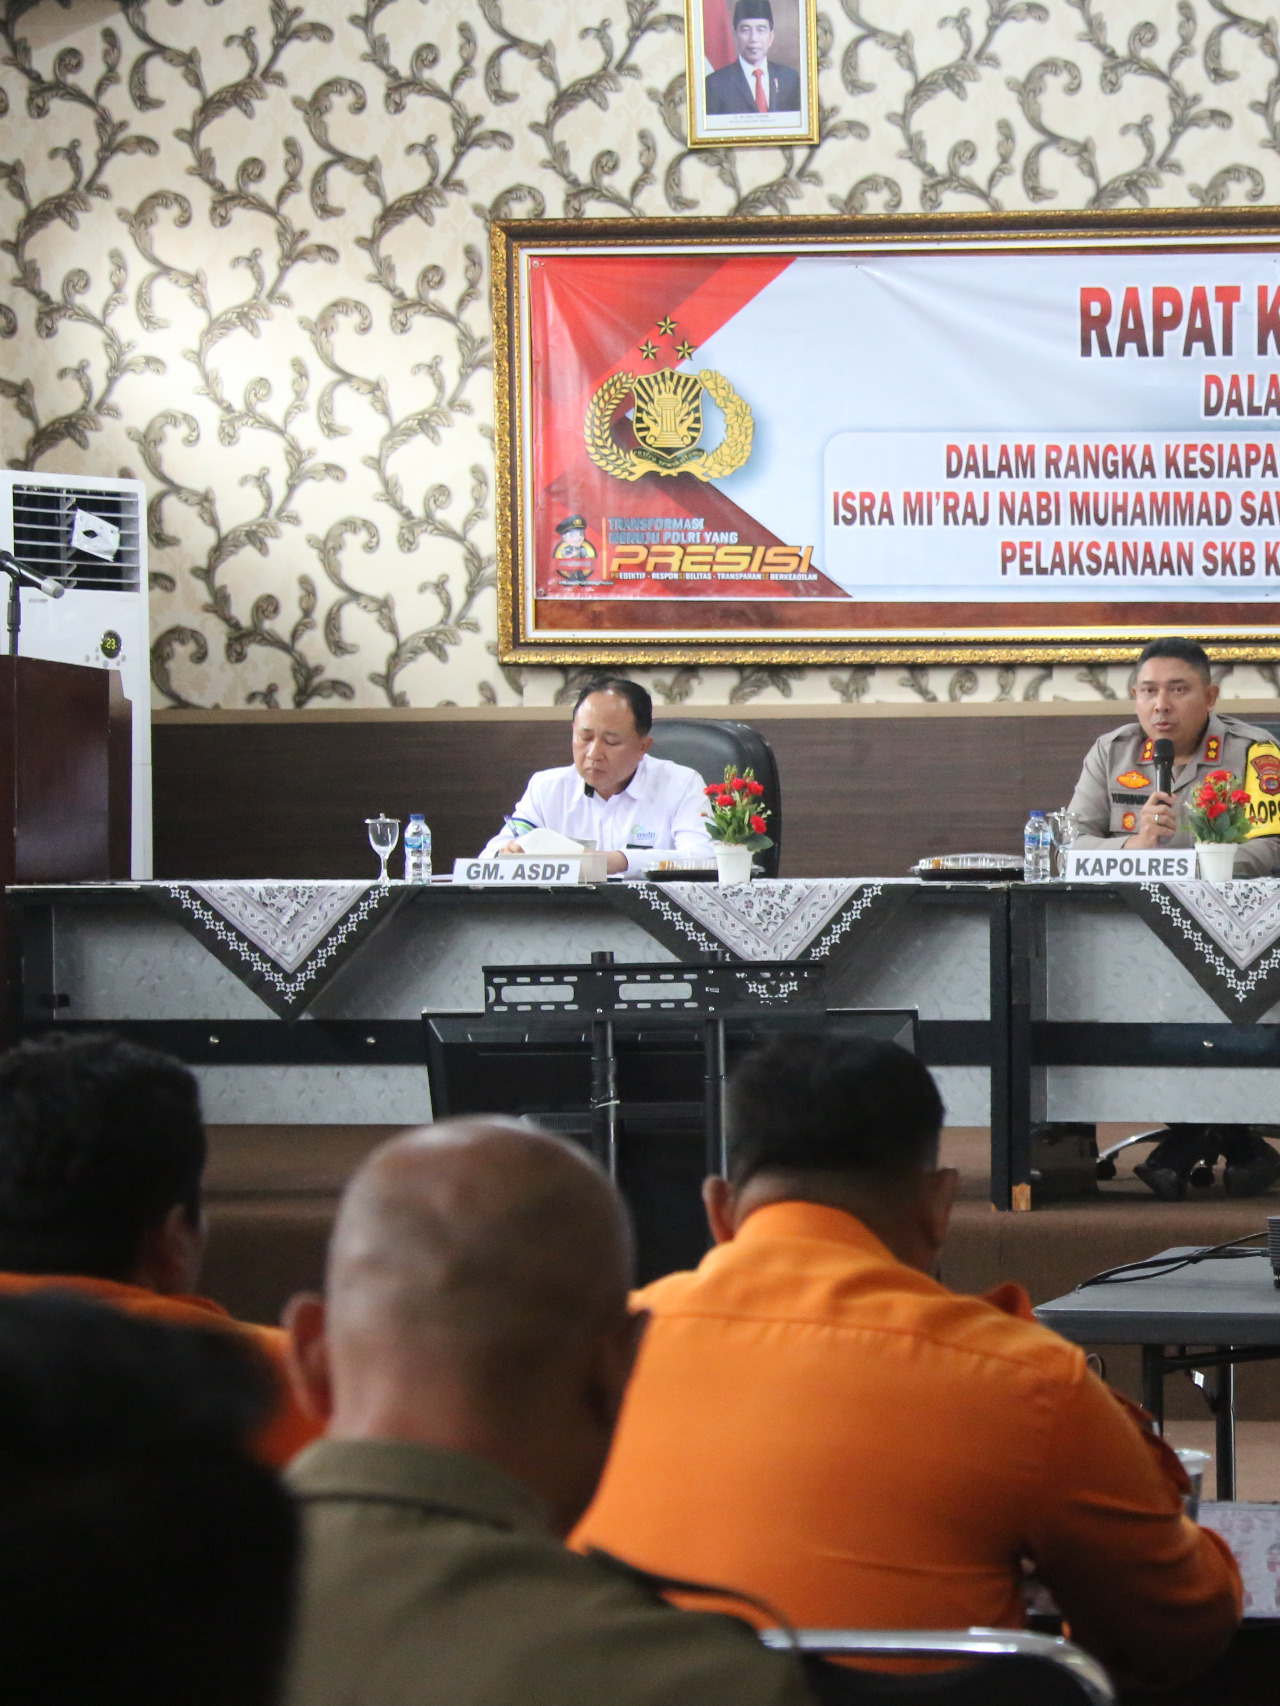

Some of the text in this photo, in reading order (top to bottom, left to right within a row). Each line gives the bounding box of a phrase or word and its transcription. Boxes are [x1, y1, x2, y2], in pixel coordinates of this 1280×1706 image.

[1080, 286, 1240, 357] RAPAT
[946, 444, 1035, 479] DALAM
[1045, 444, 1156, 479] RANGKA
[833, 491, 895, 526] ISRA
[903, 491, 989, 526] MI'RAJ
[999, 491, 1060, 526] NABI
[1070, 490, 1231, 526] MUHAMMAD
[608, 517, 705, 531] TRANSFORMASI
[609, 531, 739, 545] MENUJU POLRI YANG
[609, 545, 815, 573] PRESISI
[1001, 541, 1194, 576] PELAKSANAAN
[1202, 540, 1256, 576] SKB
[770, 572, 818, 581] BERKEADILAN
[636, 831, 656, 840] asdp
[466, 863, 570, 881] GM. ASDP
[1075, 857, 1189, 877] KAPOLRES
